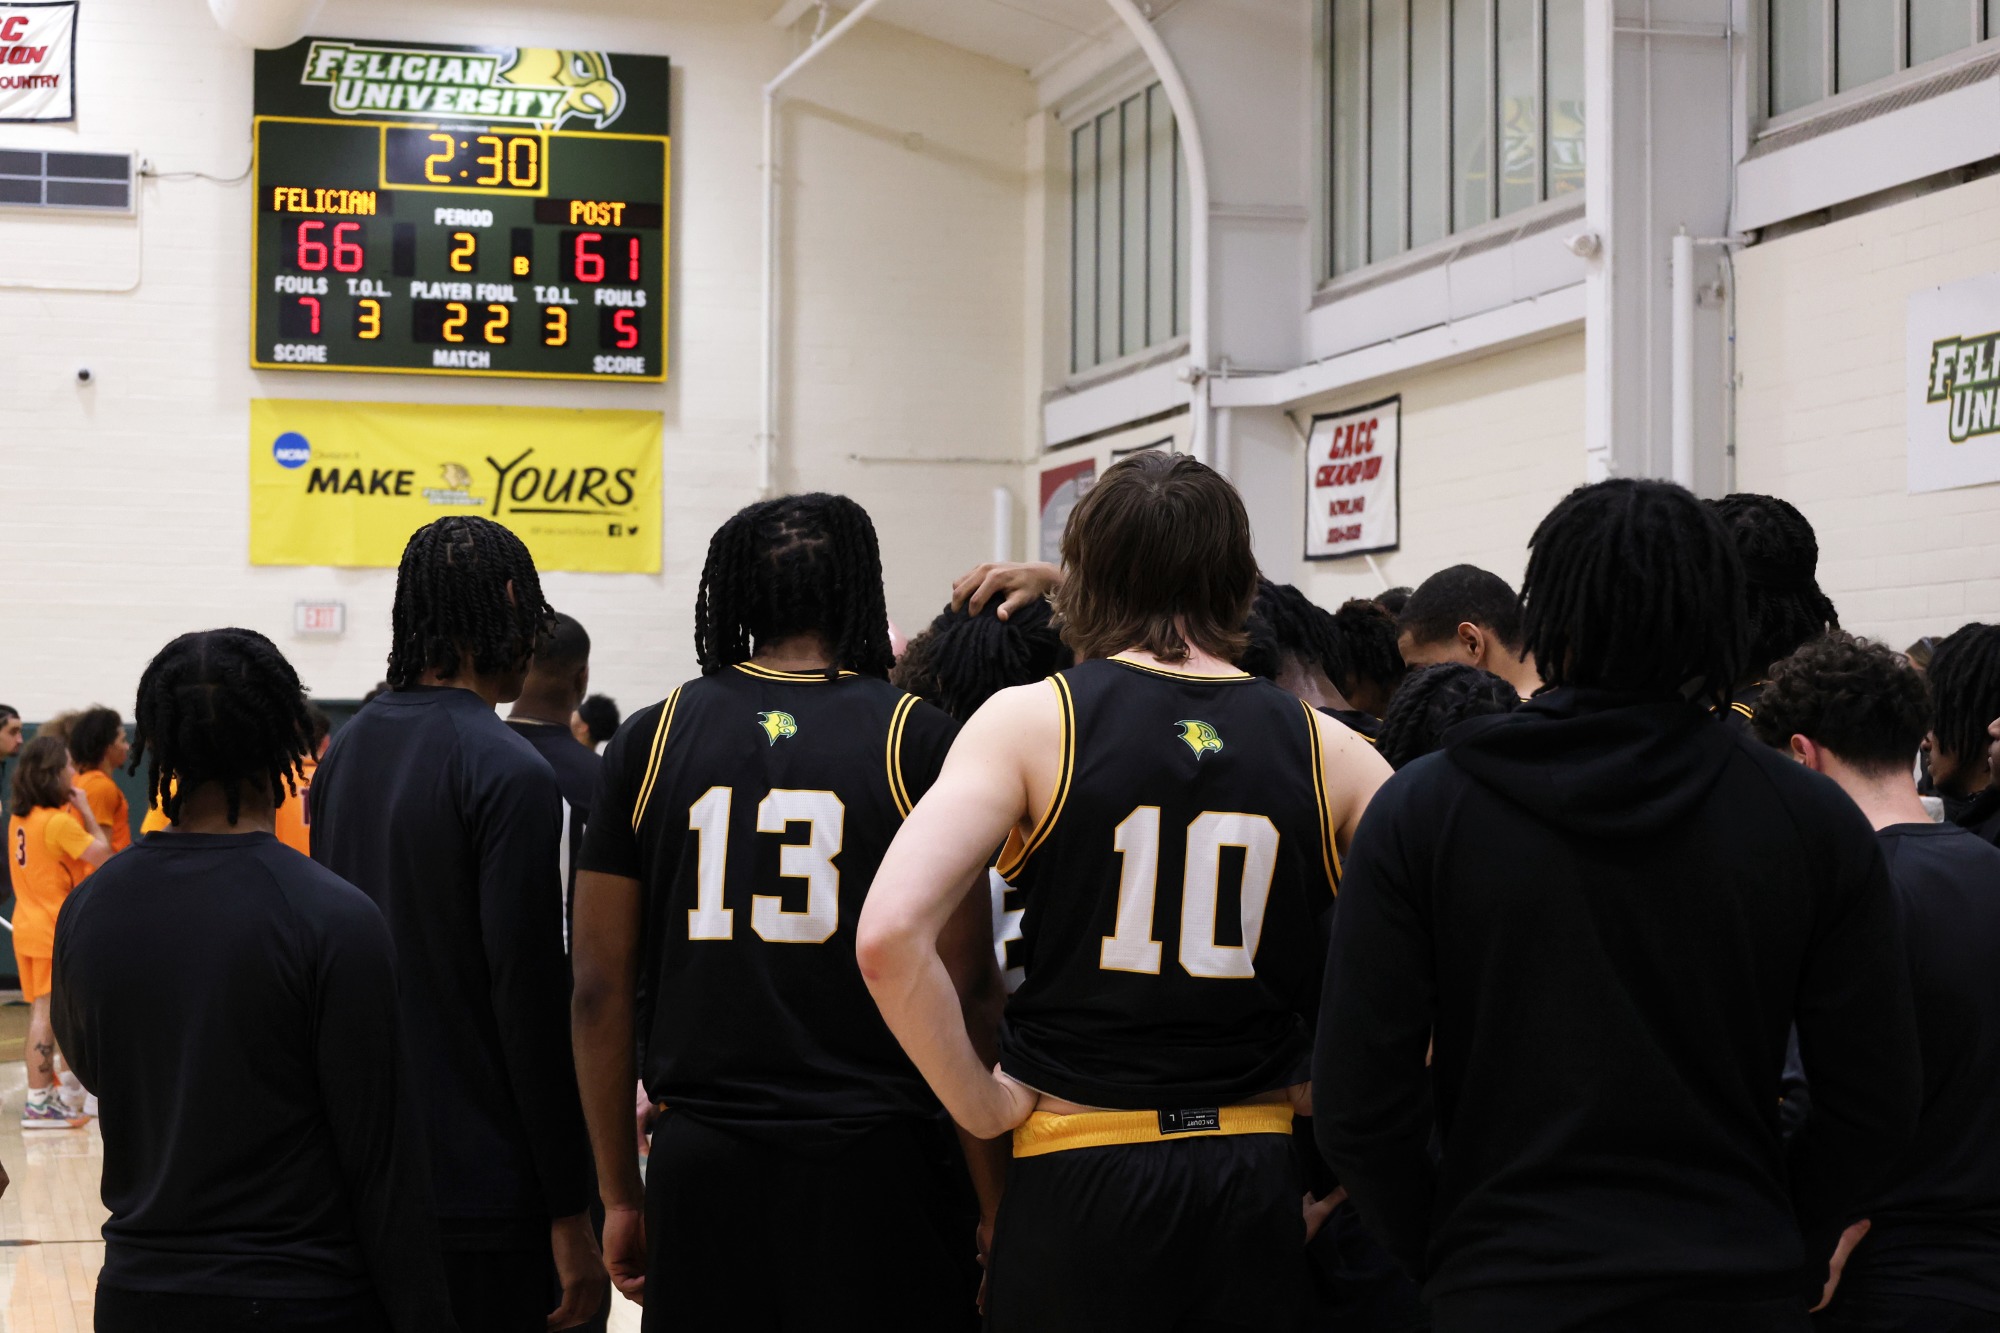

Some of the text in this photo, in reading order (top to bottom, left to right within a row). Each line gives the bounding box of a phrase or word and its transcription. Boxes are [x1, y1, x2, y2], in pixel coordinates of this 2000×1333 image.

[312, 49, 497, 87] FELICIAN
[336, 80, 566, 117] UNIVERSITY
[424, 133, 538, 187] 2:30
[273, 187, 377, 215] FELICIAN
[434, 208, 494, 228] PERIOD
[569, 200, 627, 227] POST
[297, 220, 364, 273] 66
[450, 232, 476, 272] 2
[575, 232, 639, 283] 61
[274, 275, 329, 295] FOULS
[346, 279, 392, 297] T.O.L.
[410, 281, 518, 303] PLAYER FOUL
[534, 286, 579, 305] T.O.L.
[594, 288, 647, 308] FOULS
[298, 297, 321, 334] 7
[358, 299, 381, 339] 3
[545, 306, 568, 346] 3
[613, 309, 639, 349] 5
[273, 344, 328, 363] SCORE
[433, 349, 491, 369] MATCH
[593, 355, 646, 374] SCORE
[1329, 417, 1378, 460] CACC
[306, 447, 637, 517] MAKE YOURS
[15, 827, 27, 868] 3
[687, 785, 845, 944] 13
[1099, 804, 1281, 979] 10
